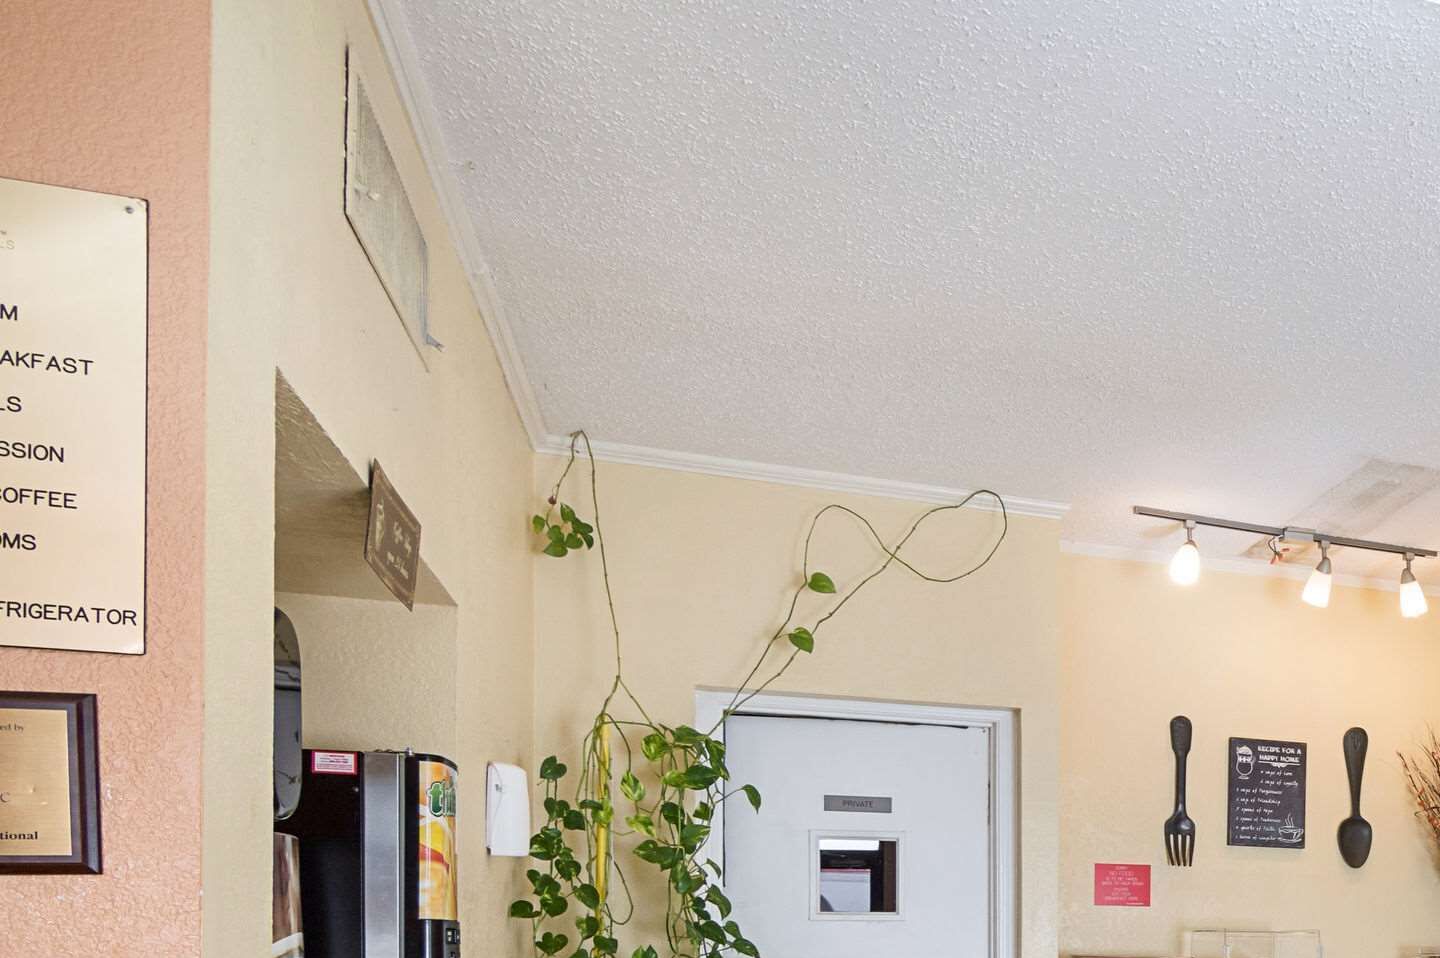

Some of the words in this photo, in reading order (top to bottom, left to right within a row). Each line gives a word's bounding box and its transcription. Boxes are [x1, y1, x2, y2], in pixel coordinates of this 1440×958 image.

[0, 350, 94, 375] AKFAST
[0, 441, 64, 462] SSION
[0, 487, 77, 509] OFFEE
[0, 532, 37, 551] MS
[842, 799, 874, 809] PRIVATE
[0, 831, 38, 840] tional
